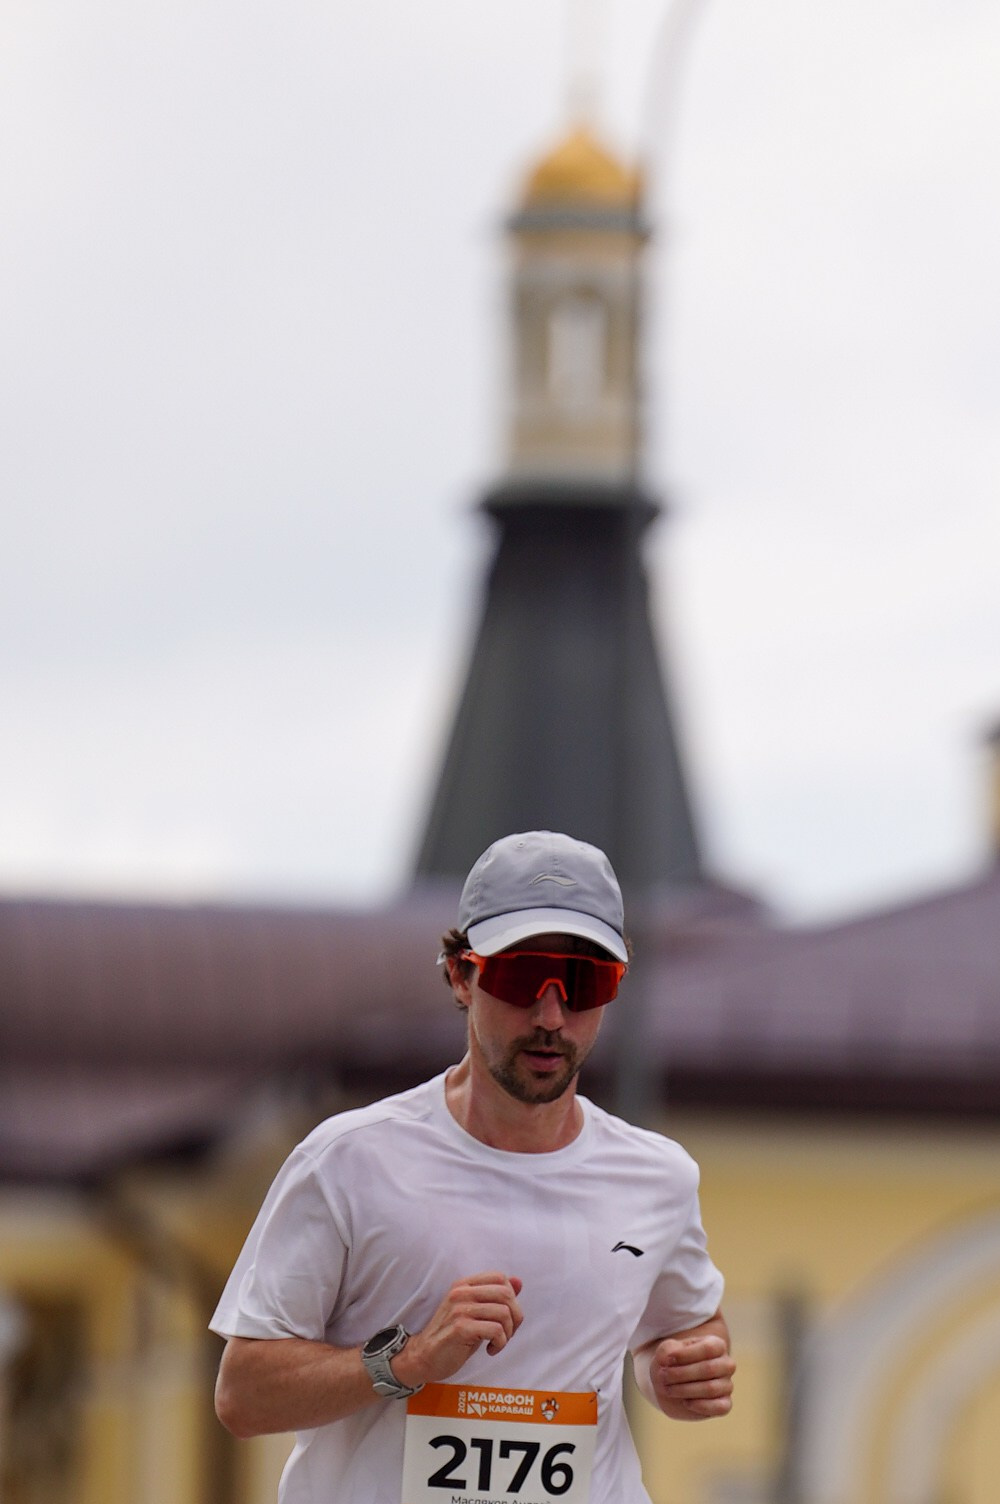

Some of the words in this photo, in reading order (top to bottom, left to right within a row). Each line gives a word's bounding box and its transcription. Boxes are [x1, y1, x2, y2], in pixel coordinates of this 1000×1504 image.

[457, 1391, 466, 1413] 2026
[467, 1392, 534, 1405] МАРАФОН
[488, 1405, 534, 1415] КАРАБАШ
[427, 1435, 576, 1496] 2176
